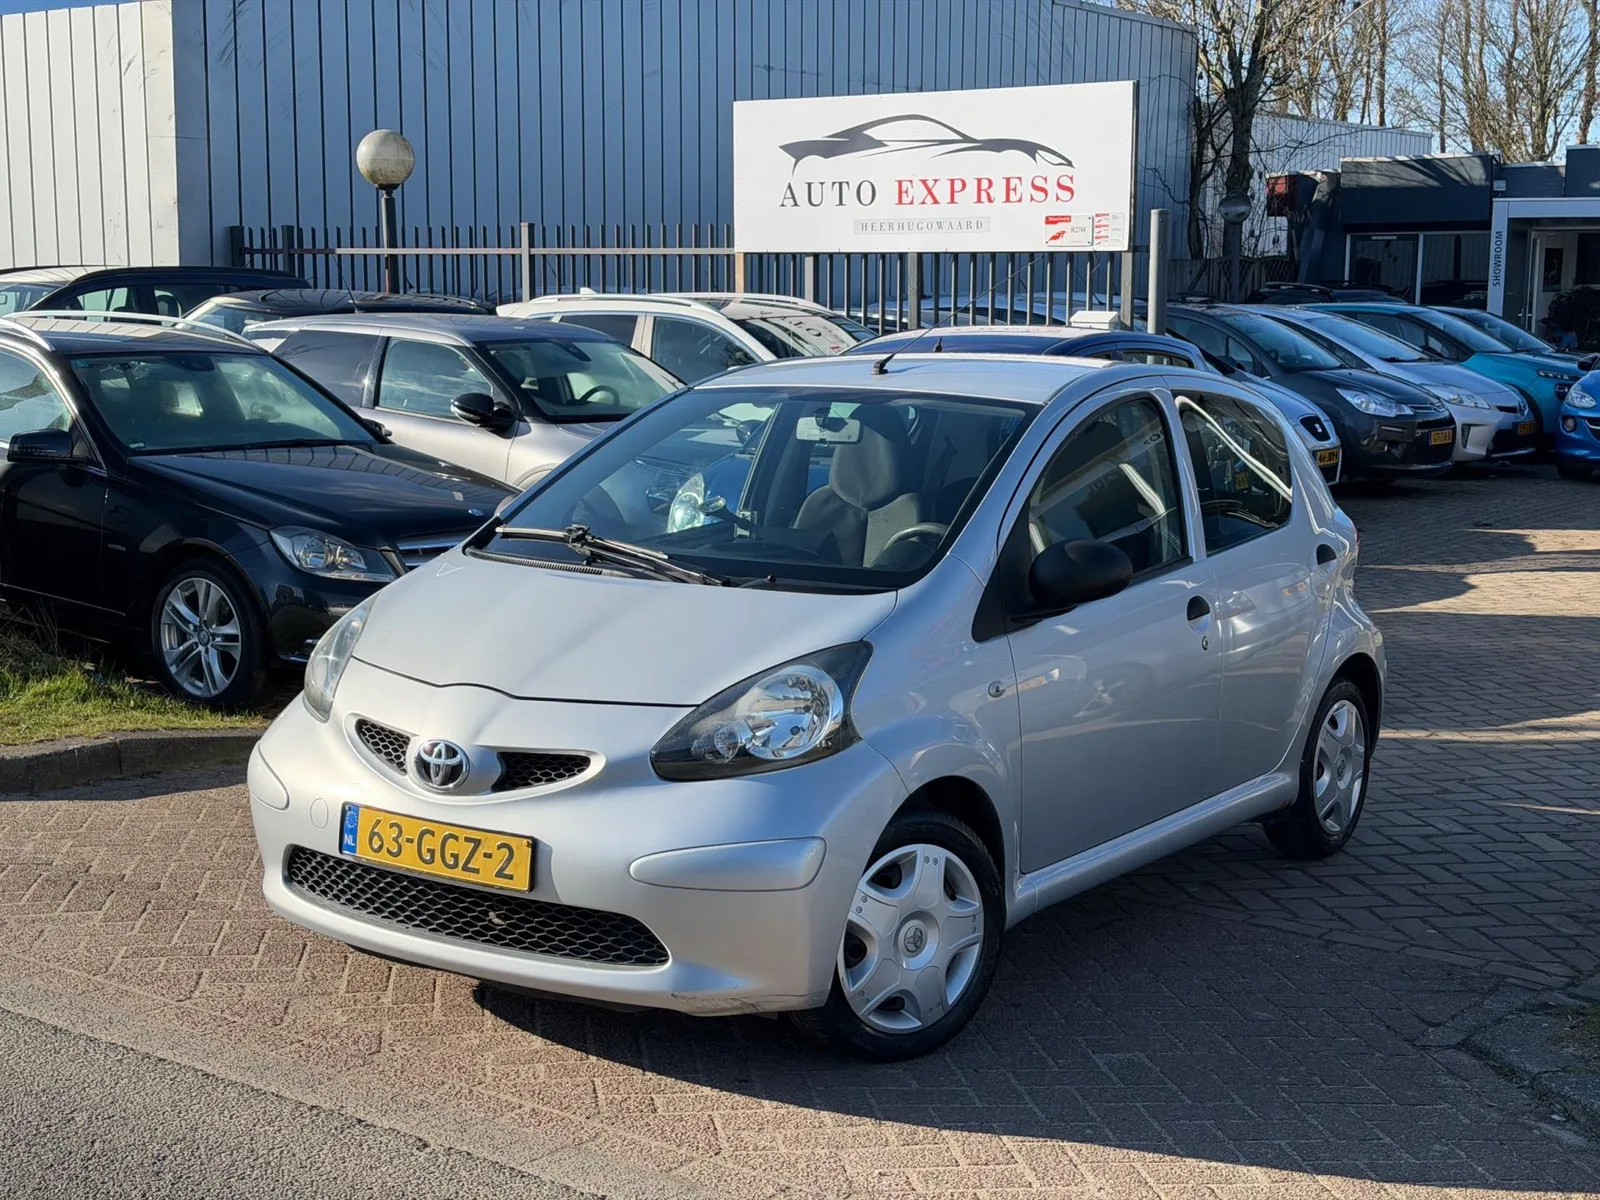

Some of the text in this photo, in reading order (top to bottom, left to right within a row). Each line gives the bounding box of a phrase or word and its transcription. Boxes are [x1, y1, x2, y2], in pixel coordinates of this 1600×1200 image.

[779, 173, 1075, 208] AUTO EXPRESS
[860, 219, 983, 232] HEERHUGOWAARD
[1492, 230, 1503, 287] SHOWROOM
[344, 833, 356, 846] NL
[367, 818, 515, 881] 63-GGZ-2
